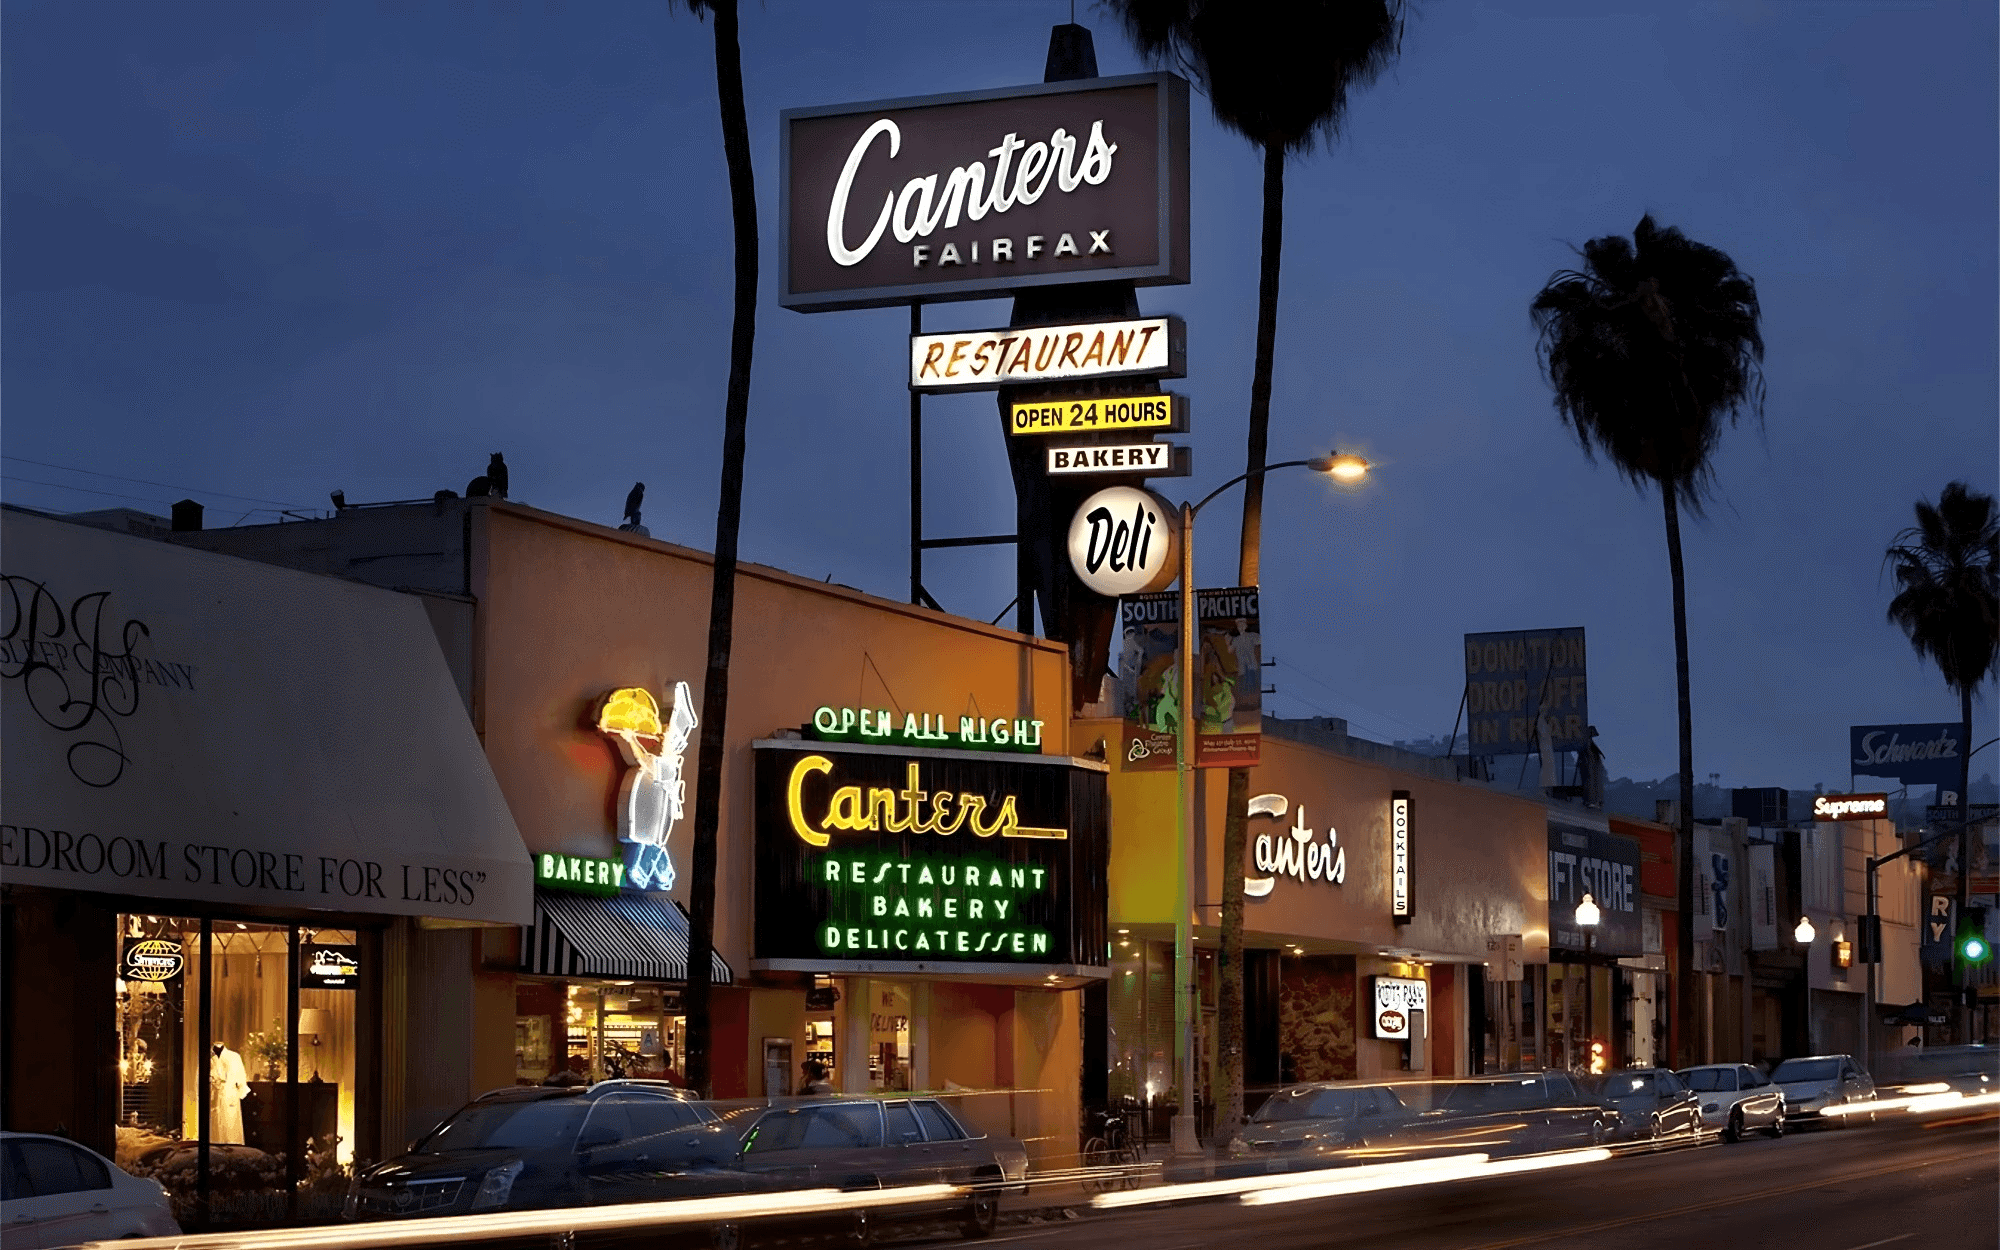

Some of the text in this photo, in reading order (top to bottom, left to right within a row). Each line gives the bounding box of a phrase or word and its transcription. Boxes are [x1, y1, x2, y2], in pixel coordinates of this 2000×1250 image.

[827, 118, 1118, 266] Canters
[912, 229, 1113, 268] FAIRFAX
[920, 326, 1160, 379] RESTAURANT
[1015, 401, 1167, 428] OPEN 24 HOURS
[1054, 447, 1161, 468] BAKERY
[1086, 502, 1157, 575] Deli
[1124, 595, 1258, 622] SOUTH PACIFIC
[1466, 636, 1584, 673] DONATION
[1469, 679, 1527, 714] DROP
[814, 706, 1045, 746] OPEN ALL NIGHT
[1473, 720, 1501, 744] IN
[787, 755, 1068, 848] Canters
[1814, 797, 1885, 819] Supreme
[0, 825, 169, 881] EDROOM
[183, 843, 305, 892] STORE
[318, 857, 387, 898] FOR
[541, 853, 625, 888] BAKERY
[825, 860, 1046, 890] RESTAURANT
[1395, 804, 1406, 912] COCKTAILS
[1581, 857, 1634, 913] STORE
[873, 896, 1009, 920] BAKERY
[825, 926, 1048, 954] DELICATESSEN
[870, 1012, 908, 1032] DELIVER
[644, 1033, 653, 1047] A
